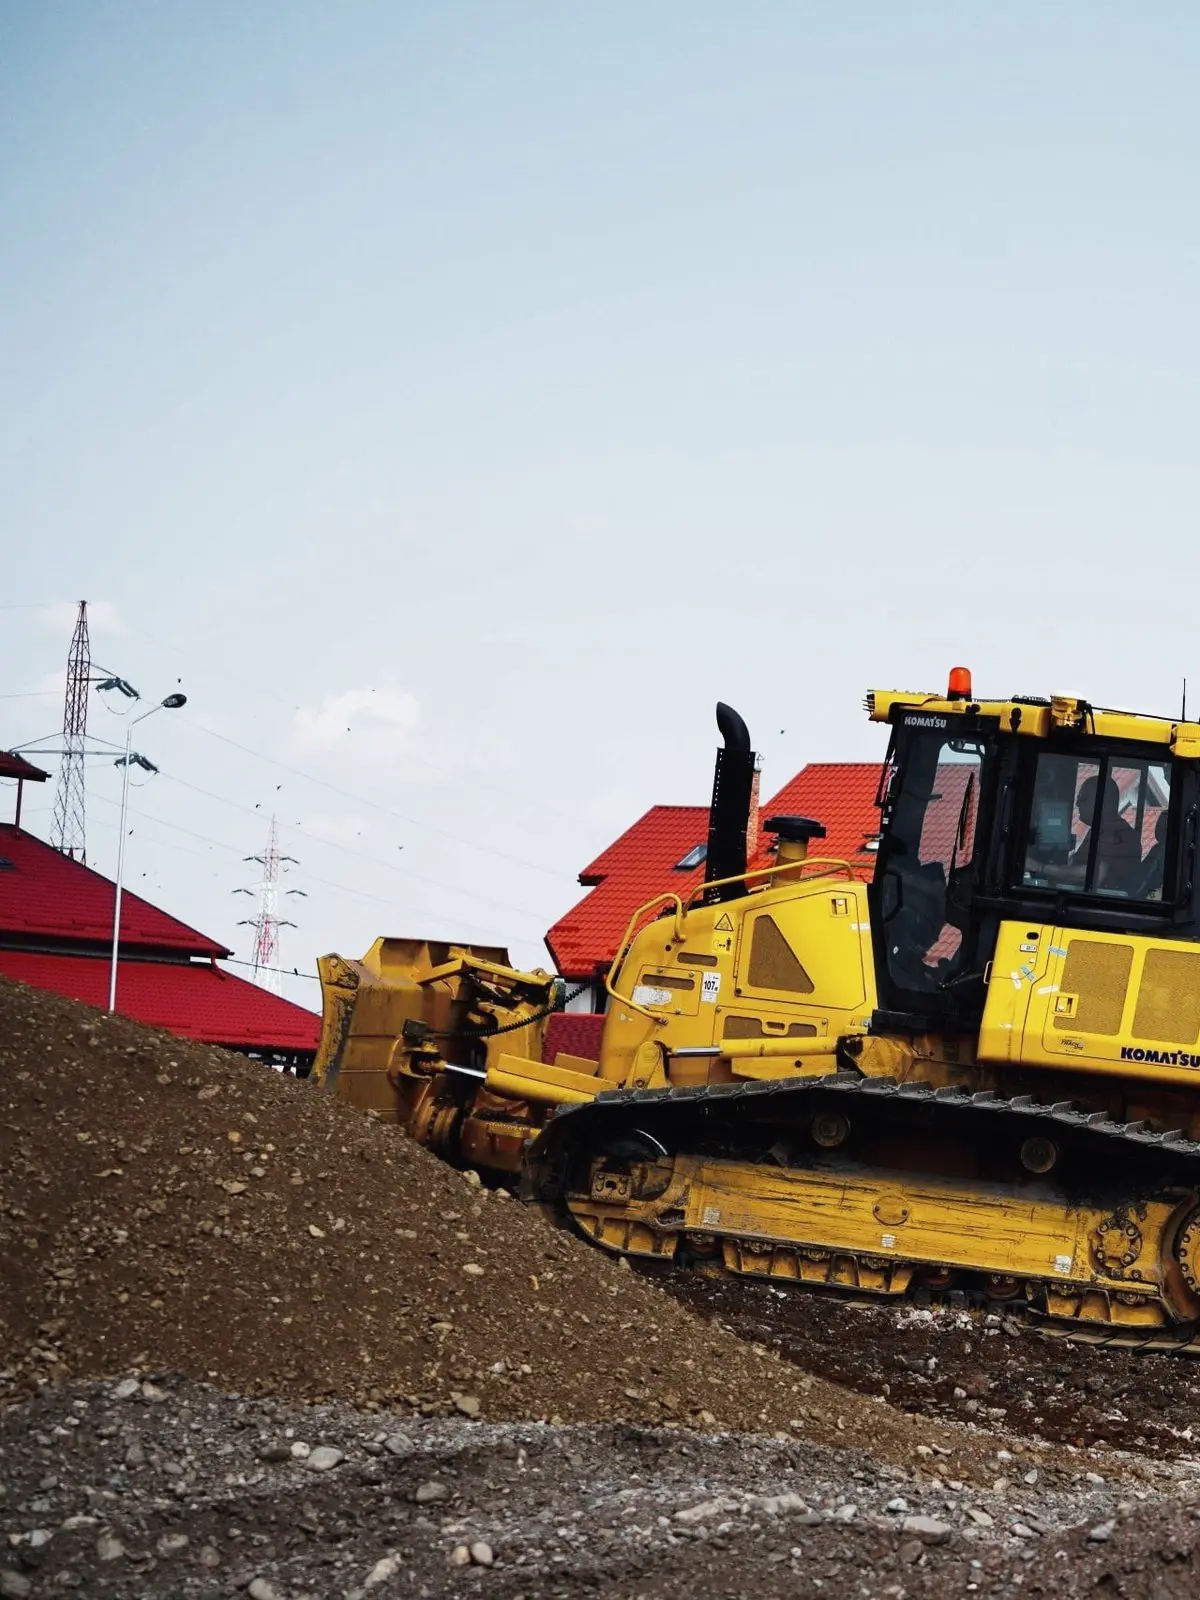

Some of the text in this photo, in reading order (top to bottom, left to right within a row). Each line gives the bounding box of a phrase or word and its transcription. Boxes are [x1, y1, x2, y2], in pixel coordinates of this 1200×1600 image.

[904, 716, 947, 728] KOMATSU
[704, 980, 716, 991] 107
[1120, 1046, 1200, 1068] KOMATSU
